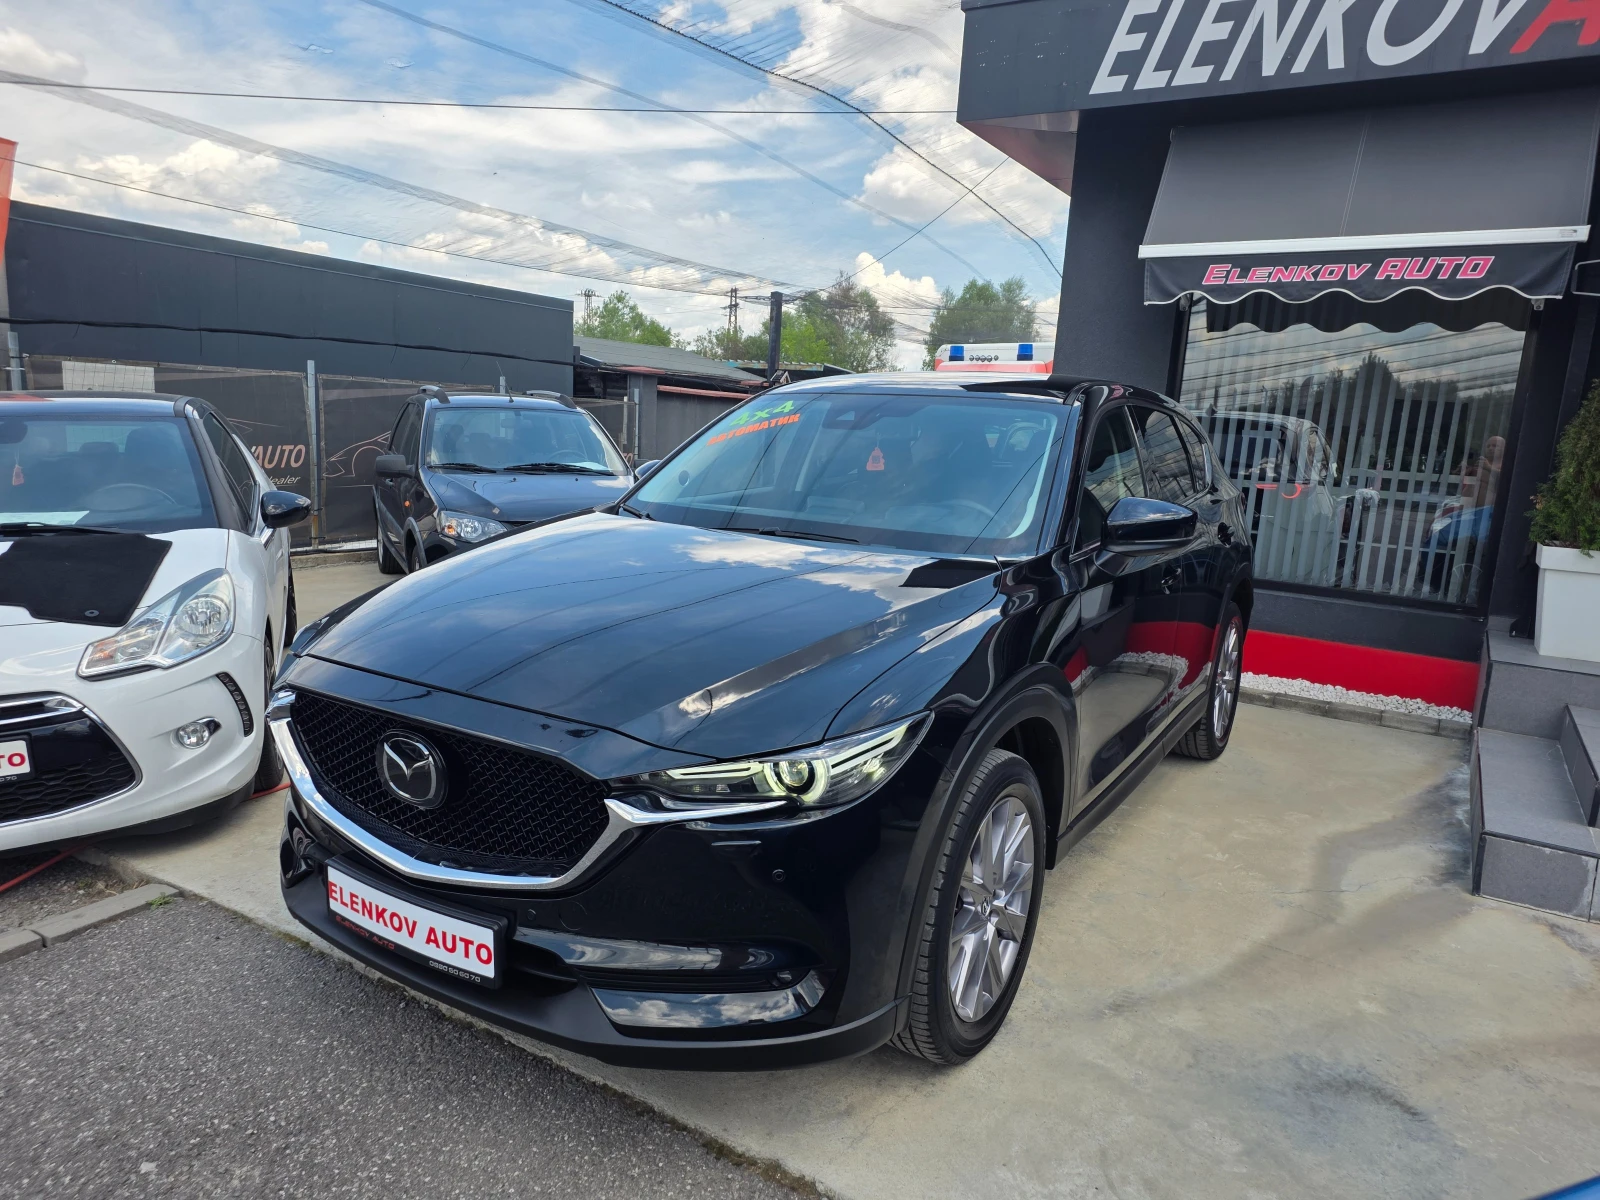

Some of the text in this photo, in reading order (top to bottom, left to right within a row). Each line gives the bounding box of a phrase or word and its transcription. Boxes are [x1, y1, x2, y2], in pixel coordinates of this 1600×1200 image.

[1202, 256, 1495, 285] ELENKOV AUTO
[328, 881, 493, 965] ELENKOV AUTO
